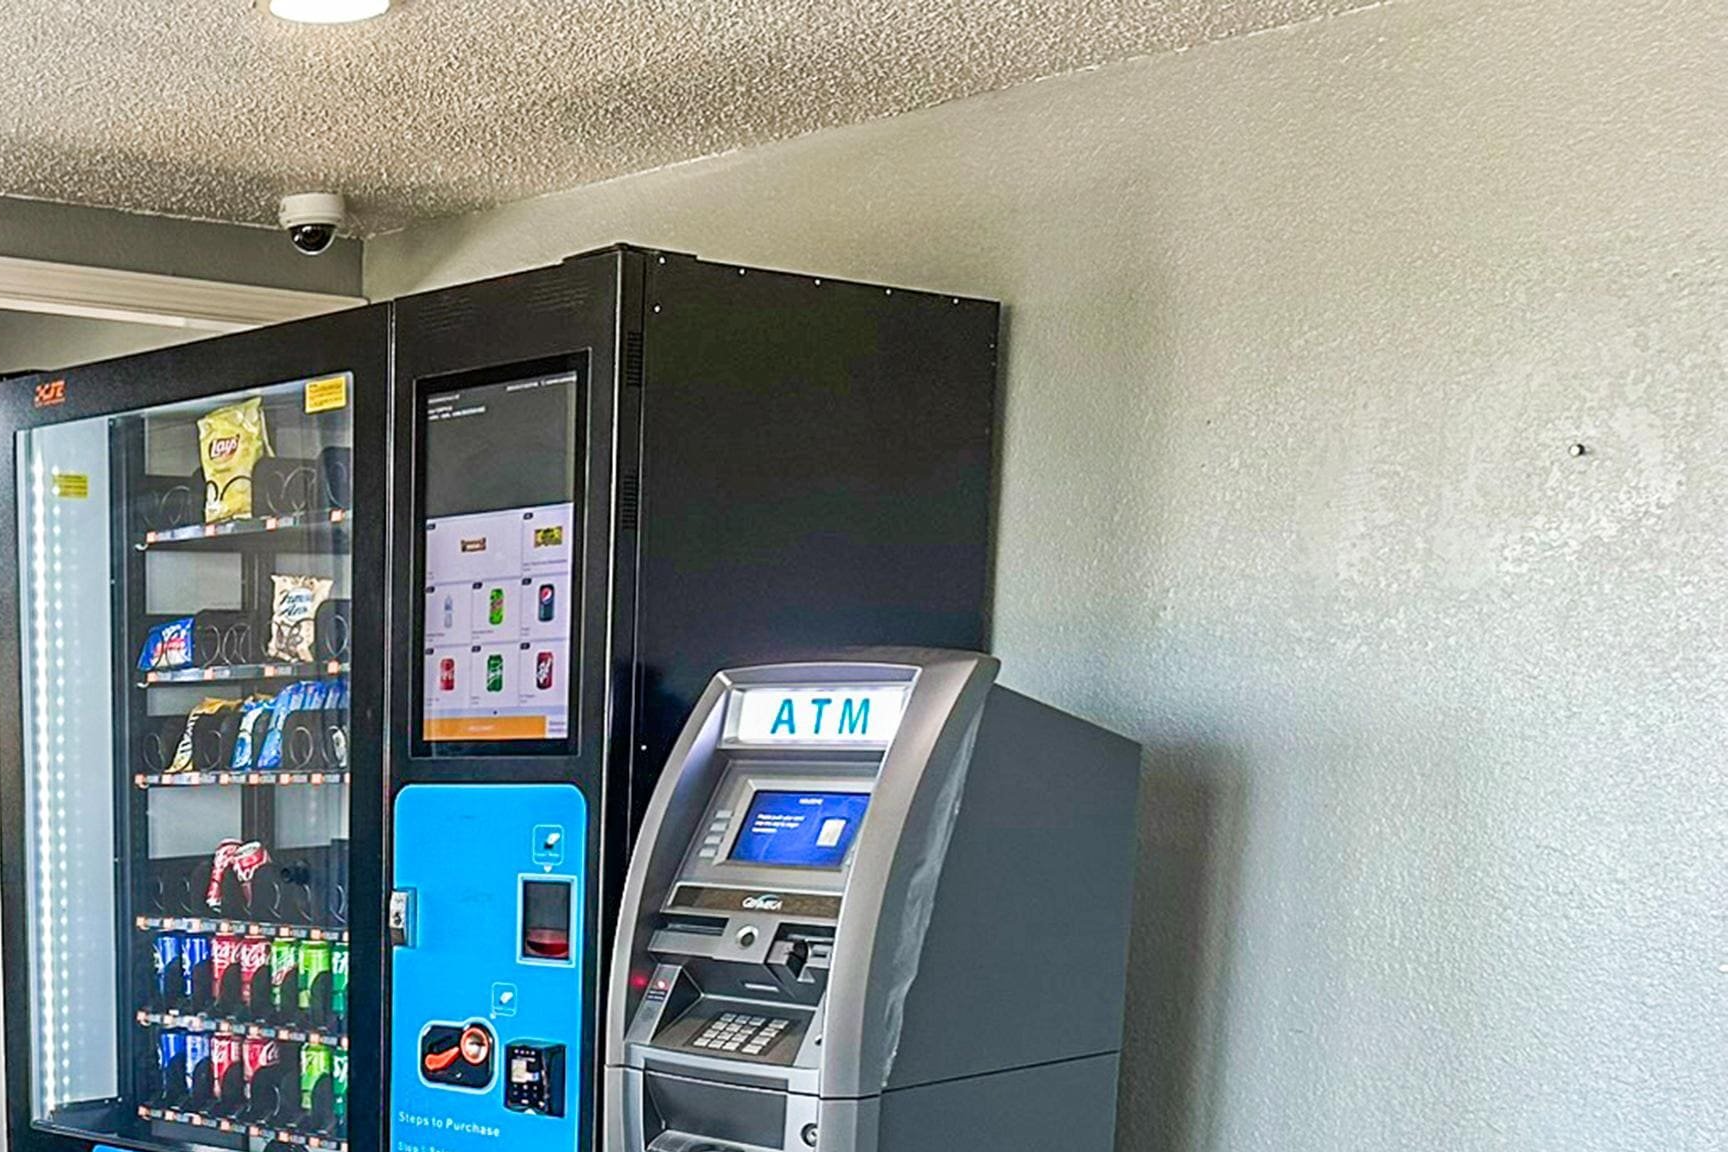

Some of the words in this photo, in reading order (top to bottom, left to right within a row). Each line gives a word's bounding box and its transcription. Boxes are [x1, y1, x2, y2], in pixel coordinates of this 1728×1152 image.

[770, 698, 870, 735] ATM
[398, 1111, 430, 1127] Steps
[431, 1117, 444, 1129] to
[445, 1117, 501, 1138] Purchase
